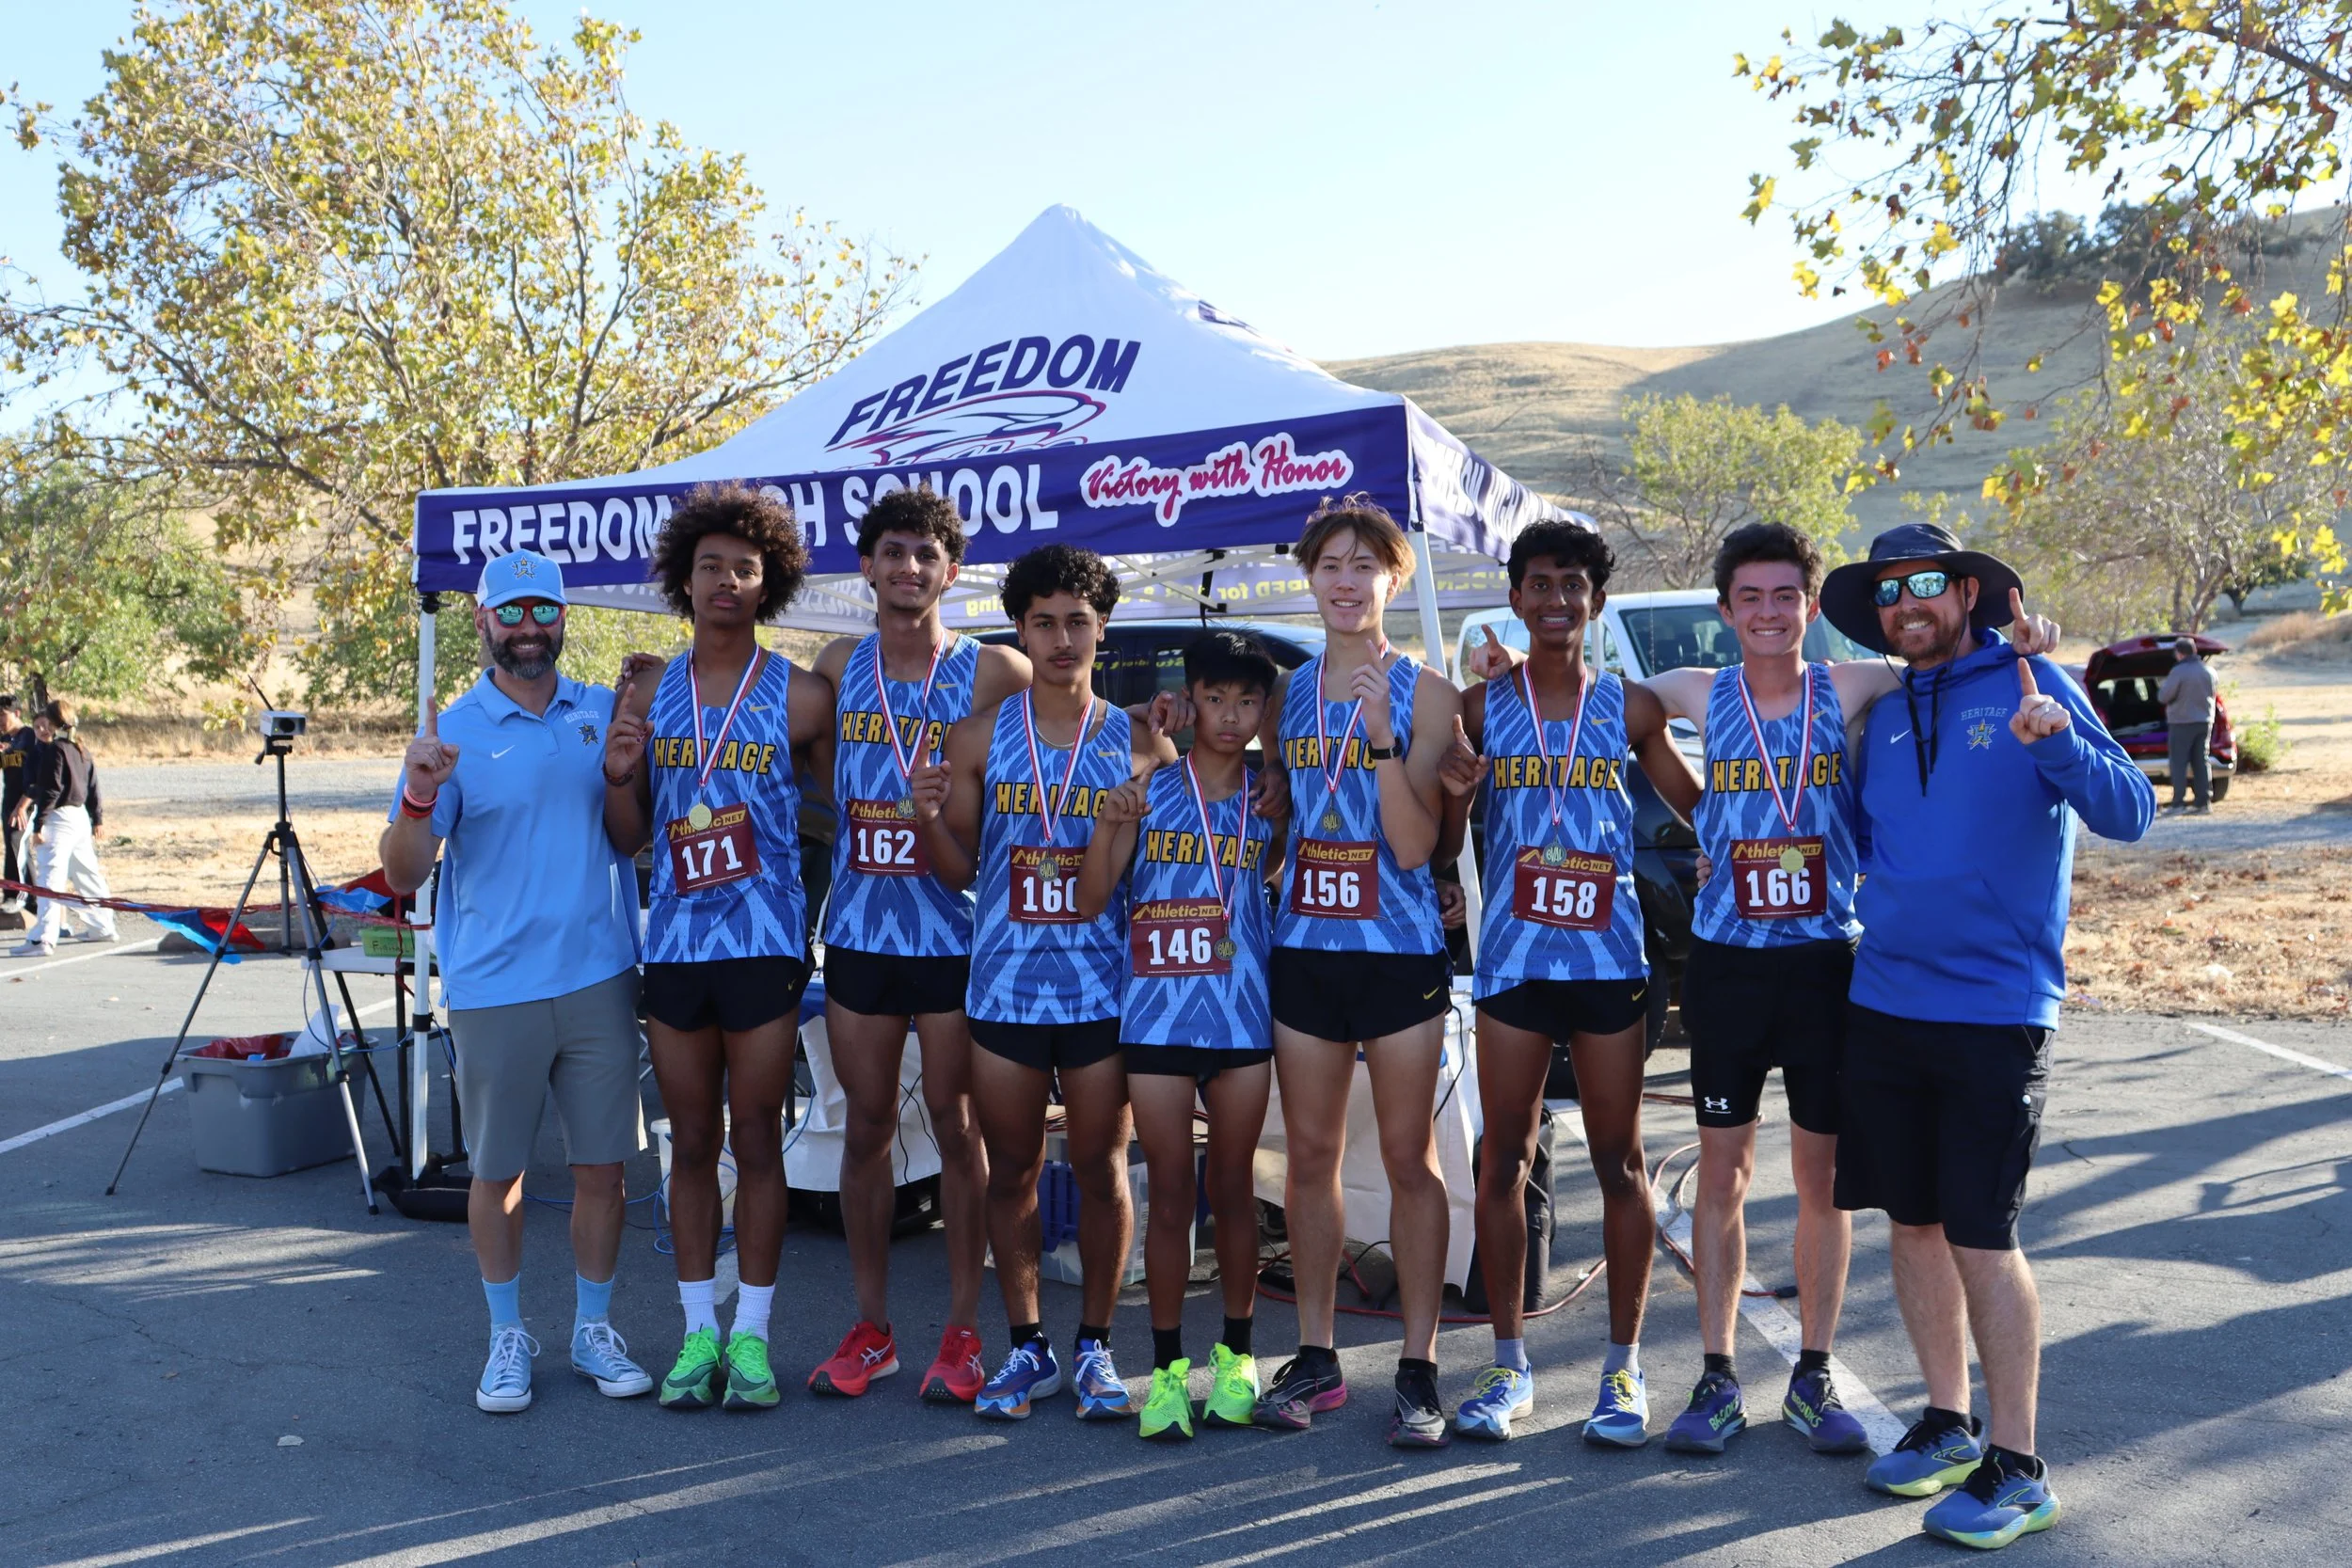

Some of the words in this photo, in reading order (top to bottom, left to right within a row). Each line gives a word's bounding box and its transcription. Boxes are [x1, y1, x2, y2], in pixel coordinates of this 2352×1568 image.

[824, 334, 1141, 449] FREEDOM
[1088, 463, 1183, 520] Victory
[1189, 449, 1250, 492] with
[1259, 439, 1346, 489] Honor
[1493, 755, 1621, 790] HERITAGE
[681, 834, 743, 880] 171
[857, 828, 915, 864] 162
[1350, 850, 1372, 860] NET
[1591, 861, 1611, 872] NET
[1301, 868, 1360, 909] 156
[1531, 876, 1597, 919] 158
[1746, 867, 1811, 907] 166
[1132, 902, 1200, 921] Athletic
[1200, 907, 1220, 916] NET
[1148, 927, 1212, 966] 146
